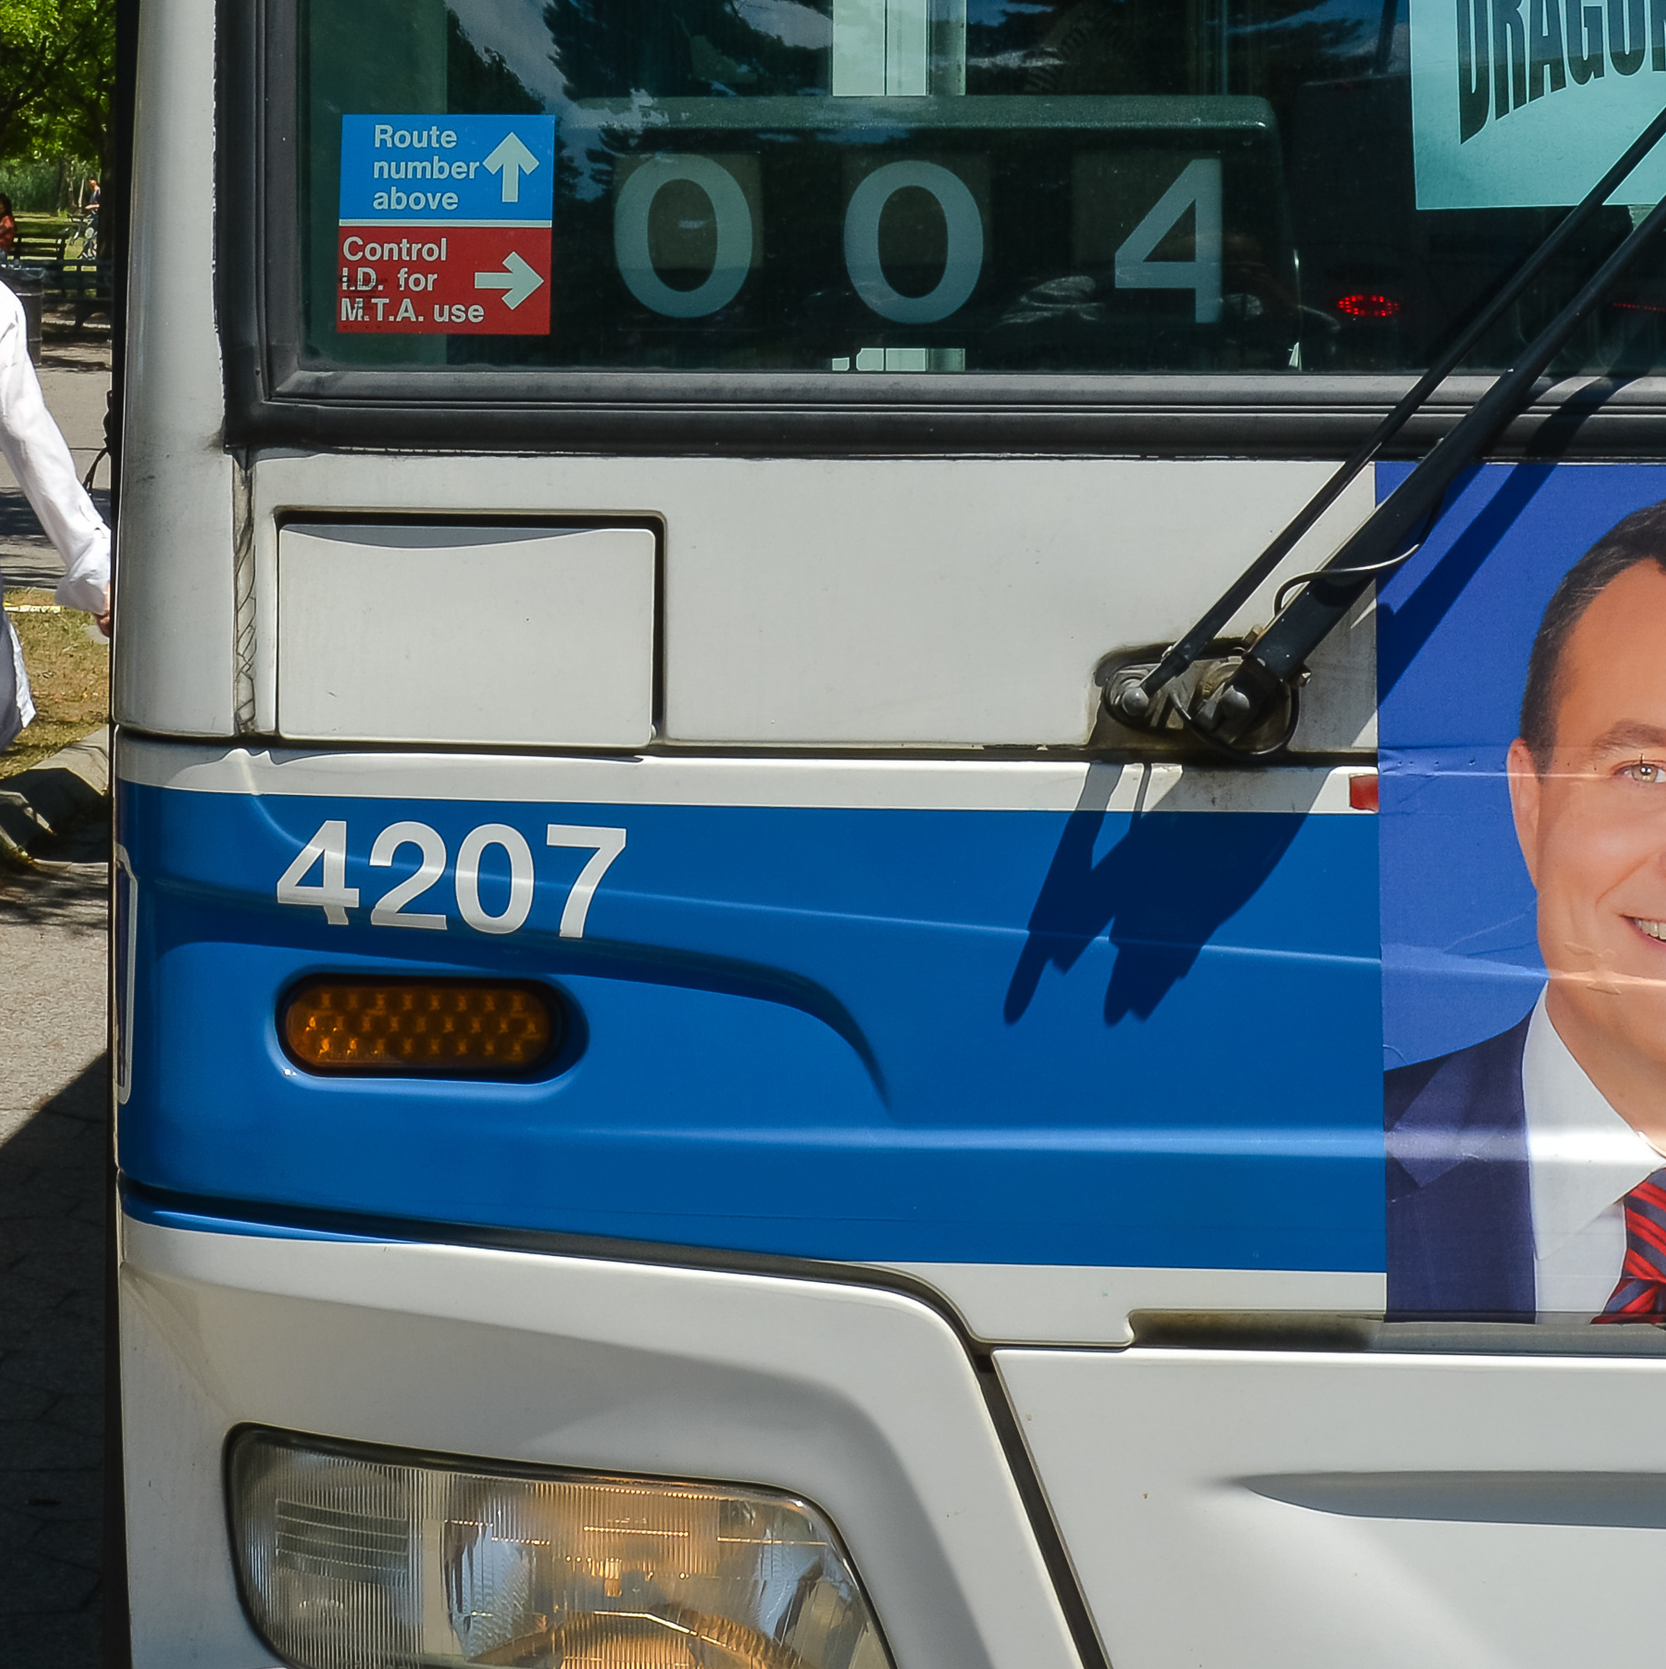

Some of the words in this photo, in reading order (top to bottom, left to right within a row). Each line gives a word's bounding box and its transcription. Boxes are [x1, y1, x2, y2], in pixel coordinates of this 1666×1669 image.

[374, 124, 458, 149] Route
[373, 155, 480, 179] number
[373, 186, 459, 210] above
[343, 236, 447, 261] Control
[342, 268, 384, 292] I.D.
[398, 268, 438, 291] for
[341, 298, 424, 322] M.T.A.
[434, 305, 485, 323] use
[276, 820, 628, 939] 4207
